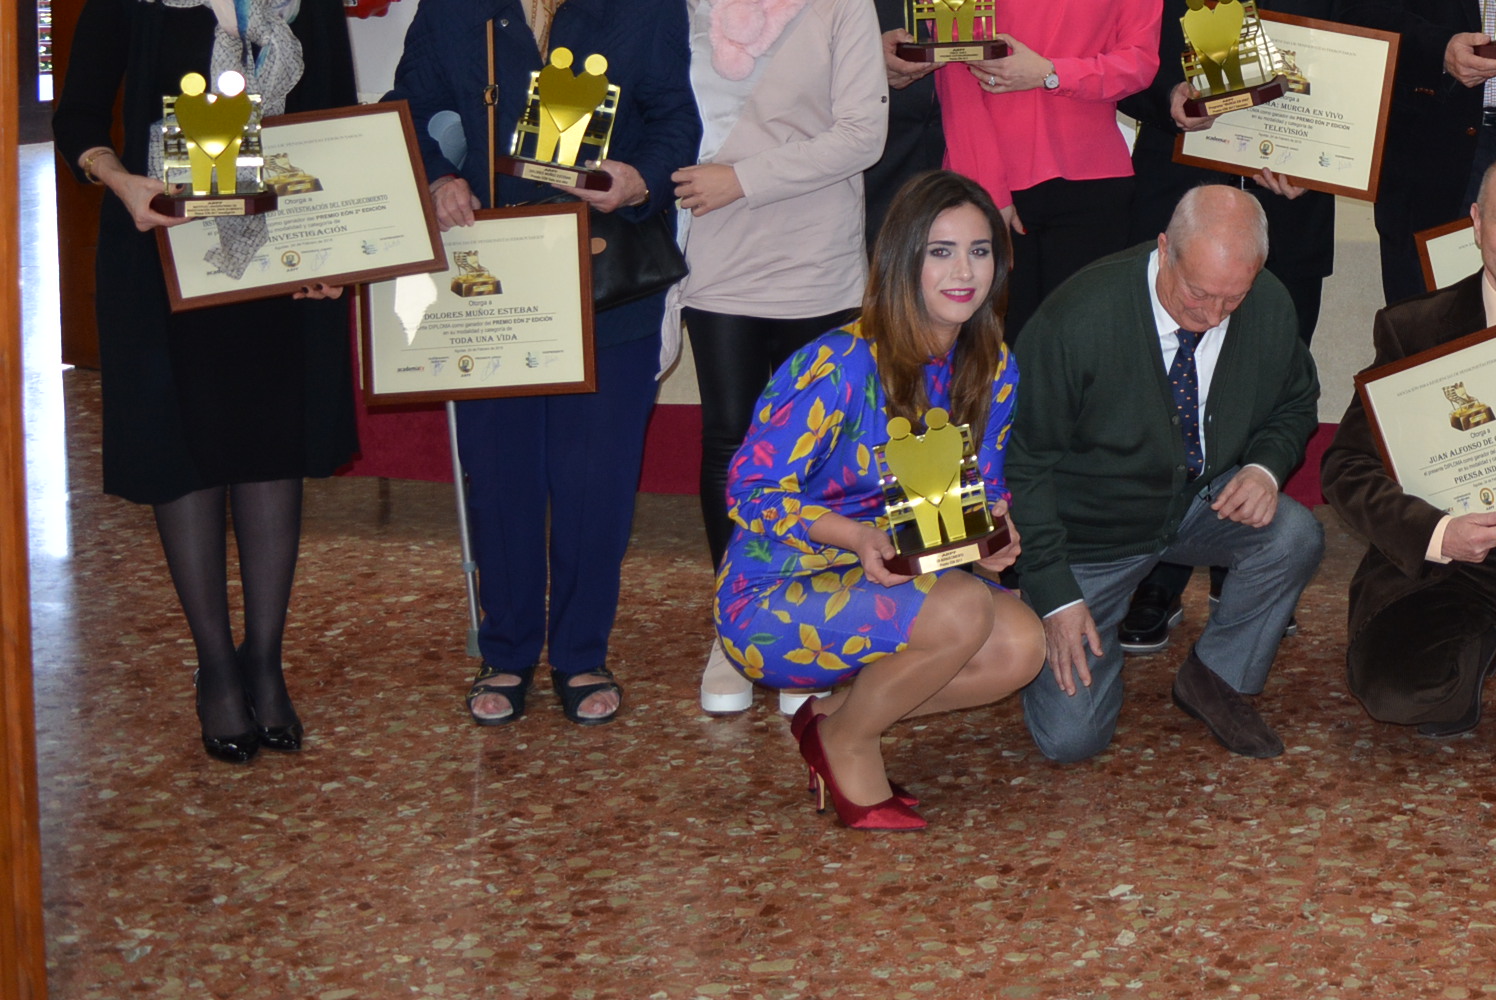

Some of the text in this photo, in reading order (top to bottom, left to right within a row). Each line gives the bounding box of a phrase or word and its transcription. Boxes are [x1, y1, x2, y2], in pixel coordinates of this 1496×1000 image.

[1281, 103, 1311, 114] MURCIA
[1325, 111, 1344, 120] VIVO
[1263, 123, 1309, 137] TELEVISIÓN
[1331, 123, 1350, 131] EDICIÓN
[285, 197, 307, 206] Otorga
[286, 202, 328, 215] INVESTIGACIÓN
[341, 194, 388, 207] ENVEJECIMIENTO
[362, 205, 387, 213] EDICIÓN
[268, 225, 348, 243] INVESTIGACIÓN
[424, 306, 538, 320] DOLORES MUÑOZ ESTEBAN
[1470, 429, 1487, 440] Otorga
[1428, 452, 1448, 464] JUAN
[1449, 441, 1482, 458] ALFONSO
[1483, 437, 1494, 446] DE
[1454, 470, 1484, 484] PRENSA
